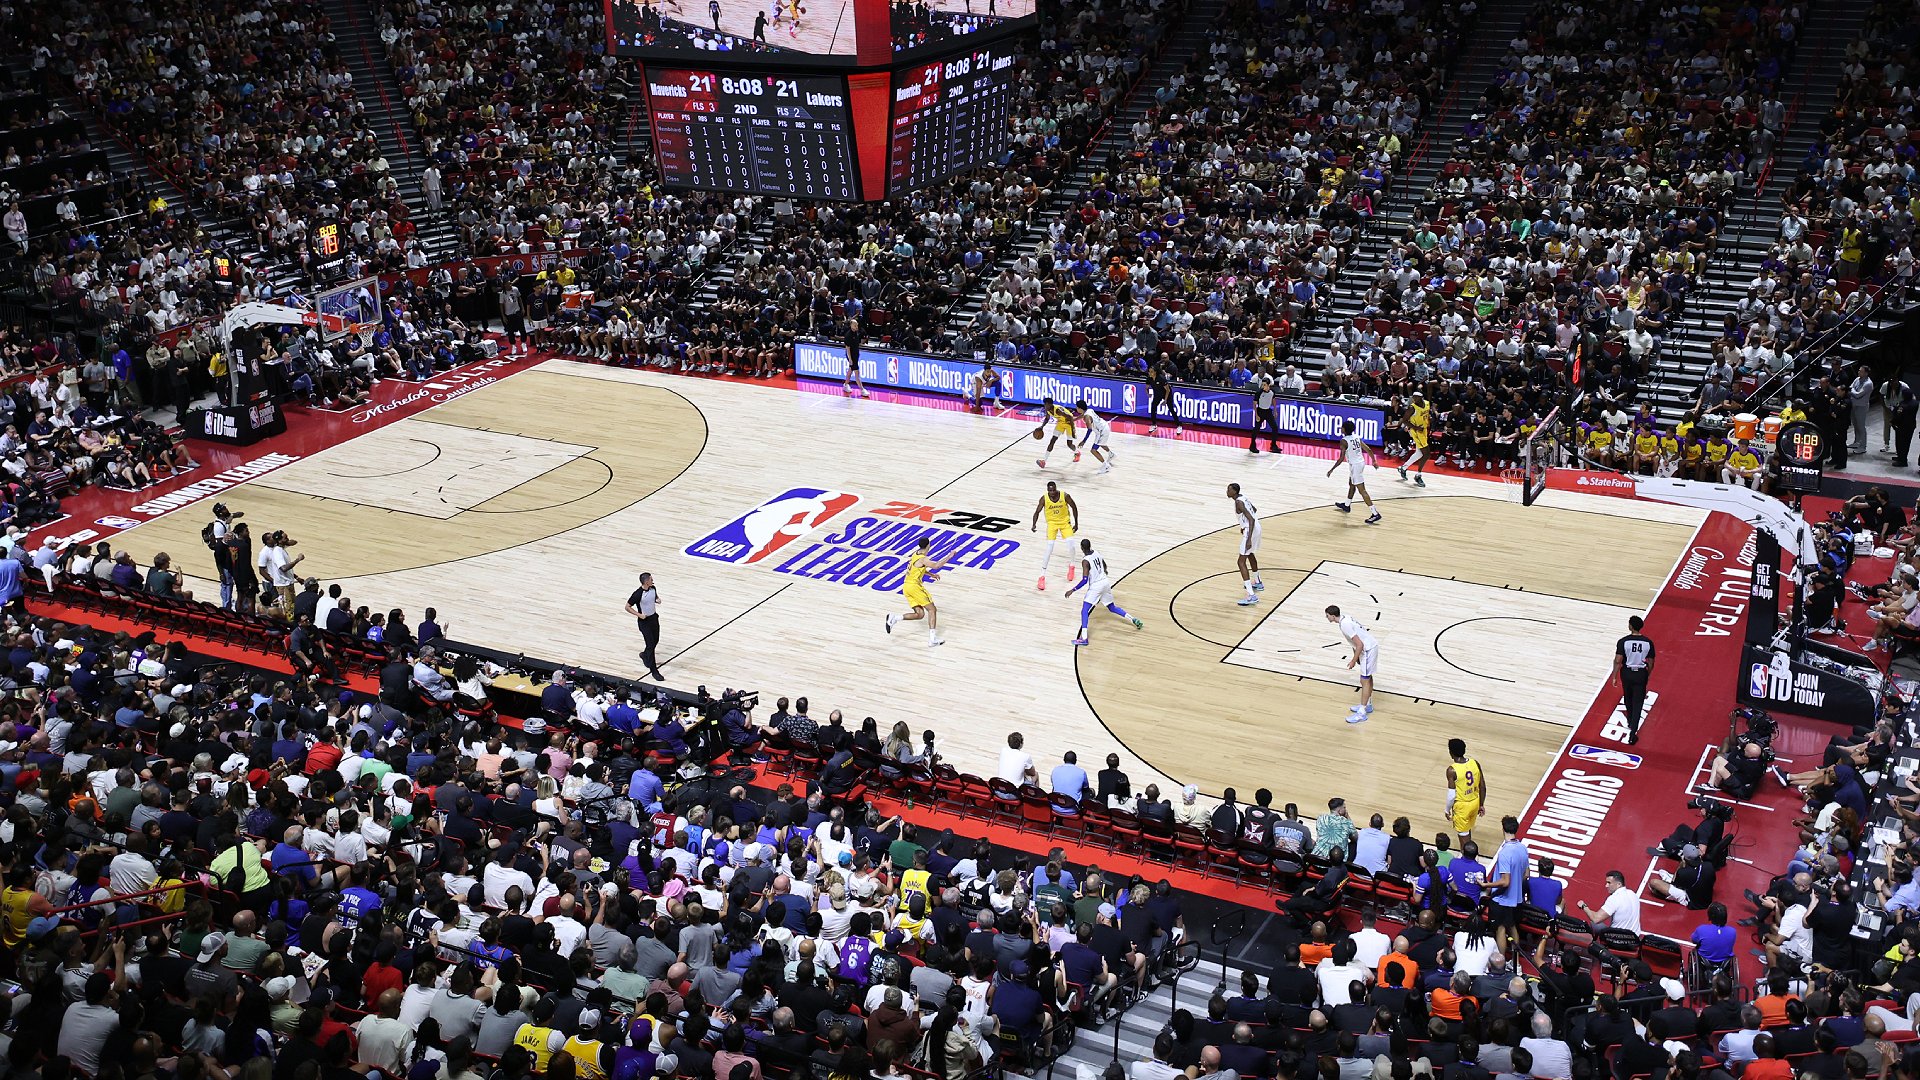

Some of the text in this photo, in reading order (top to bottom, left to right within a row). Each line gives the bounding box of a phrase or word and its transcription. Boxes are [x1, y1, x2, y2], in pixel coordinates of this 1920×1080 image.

[976, 50, 990, 70] 21
[992, 56, 1012, 72] Lakers
[924, 66, 938, 86] 21
[945, 58, 970, 80] 8:08
[650, 83, 687, 98] Mavericks
[689, 76, 711, 92] 21
[722, 78, 763, 96] 8:08
[776, 80, 798, 98] 21
[948, 84, 964, 98] 2ND
[896, 82, 922, 102] Mavericks
[806, 92, 842, 107] Lakers
[922, 97, 930, 106] FLS
[692, 102, 716, 112] FLS 3
[734, 104, 758, 114] 2ND
[776, 107, 800, 118] FLS 2
[896, 116, 908, 126] PLAYER
[686, 126, 690, 134] 8
[702, 126, 708, 136] 1
[720, 128, 724, 136] 1
[736, 128, 741, 138] 0
[782, 132, 786, 141] 7
[800, 134, 805, 142] 1
[818, 134, 823, 144] 1
[835, 136, 840, 144] 1
[688, 138, 693, 146] 3
[704, 139, 710, 148] 1
[722, 140, 726, 150] 1
[738, 142, 743, 150] 2
[784, 144, 790, 154] 3
[802, 146, 807, 155] 0
[820, 147, 825, 156] 0
[837, 148, 842, 158] 1
[690, 150, 695, 160] 8
[706, 152, 712, 162] 1
[723, 154, 728, 162] 0
[740, 154, 745, 164] 2
[692, 164, 697, 172] 0
[708, 164, 714, 174] 1
[726, 166, 730, 175] 0
[742, 168, 747, 176] 0
[786, 158, 792, 168] 0
[804, 160, 810, 168] 2
[822, 160, 827, 170] 0
[839, 162, 844, 172] 1
[694, 176, 700, 184] 0
[710, 177, 716, 186] 1
[727, 178, 732, 188] 0
[744, 180, 750, 188] 3
[788, 170, 794, 180] 3
[806, 172, 811, 182] 3
[823, 174, 828, 182] 0
[841, 174, 846, 184] 1
[790, 184, 795, 192] 0
[807, 184, 812, 194] 0
[825, 186, 830, 196] 0
[842, 188, 848, 196] 0
[319, 224, 337, 237] 8:08
[324, 235, 338, 254] 18
[220, 266, 228, 276] 18
[444, 353, 528, 384] ULTRA
[431, 377, 496, 402] Courtside
[352, 388, 430, 423] Michelob
[1350, 438, 1360, 450] 36
[1794, 433, 1818, 446] 8:08
[1796, 446, 1812, 460] 18
[1792, 467, 1820, 475] TISSOT
[131, 452, 300, 514] SUMMER LEAGUE
[870, 501, 1020, 532] 2K26
[699, 539, 740, 558] NBA
[824, 517, 1020, 570] SUMMER
[1094, 558, 1102, 570] 14
[1674, 546, 1724, 590] Courtside
[1756, 564, 1770, 574] GET
[1756, 574, 1770, 586] THE
[1758, 586, 1772, 600] App
[1694, 580, 1751, 636] ULTRA
[1632, 642, 1642, 654] 64
[1794, 672, 1819, 690] JOIN
[1793, 689, 1825, 707] TODAY
[1466, 770, 1474, 786] 9
[1526, 768, 1624, 846] SUMMER
[848, 952, 858, 969] 6
[521, 1035, 540, 1048] JAMES
